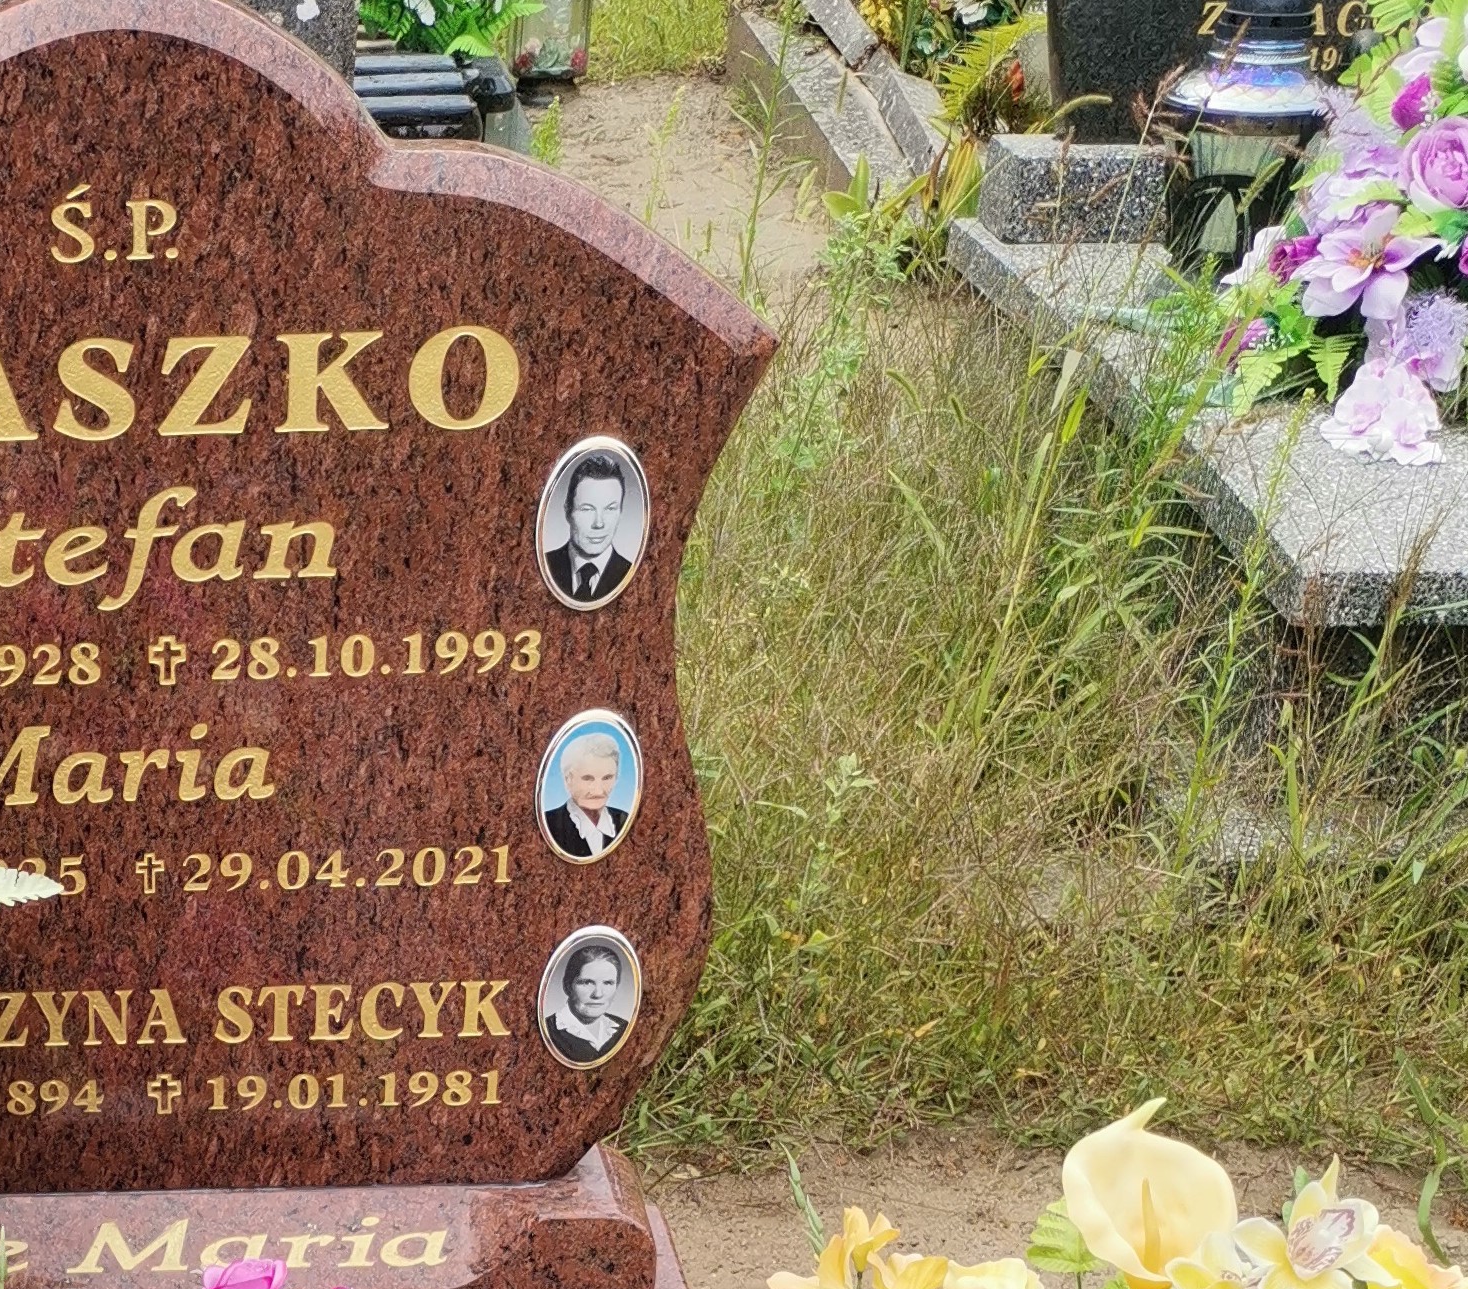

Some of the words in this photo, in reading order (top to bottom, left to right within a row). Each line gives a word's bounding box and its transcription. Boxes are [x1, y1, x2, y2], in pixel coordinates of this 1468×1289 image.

[49, 184, 180, 264] Ś.P.
[210, 629, 543, 682] 28.10.1993
[182, 843, 514, 892] 29.04.2021
[214, 978, 512, 1045] STECYK
[206, 1071, 502, 1110] 19.01.1981
[66, 1215, 449, 1275] Maria
